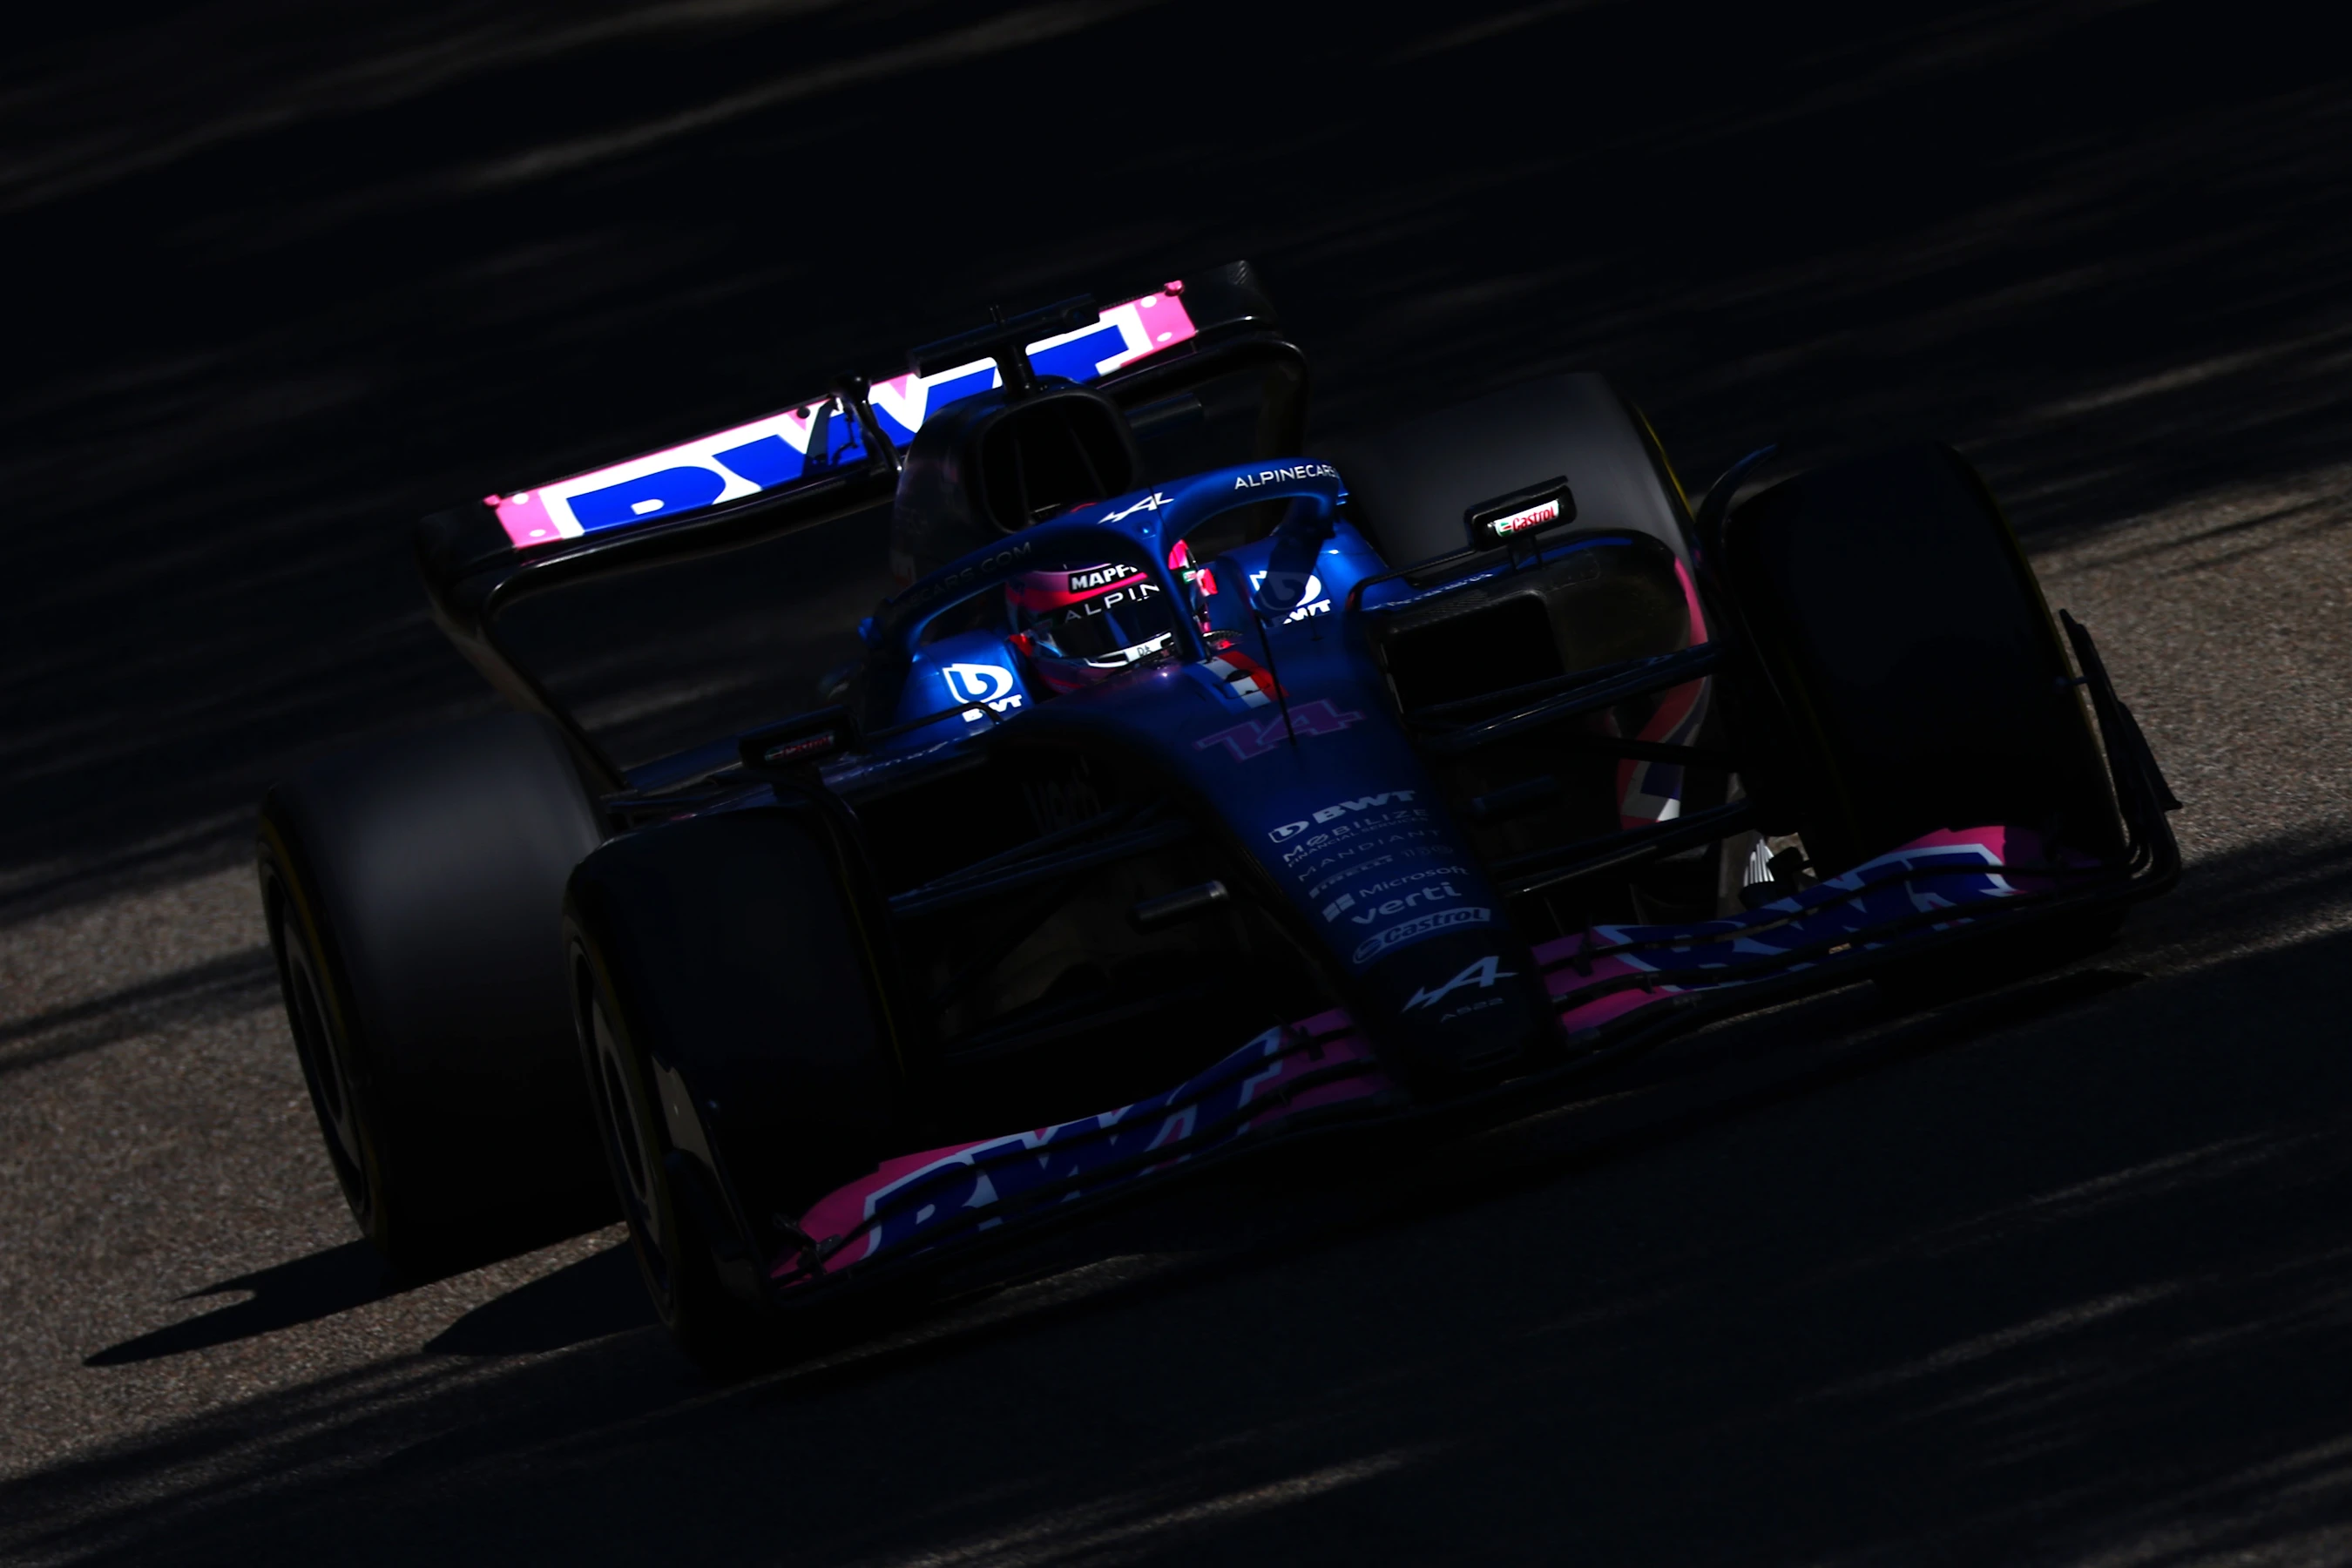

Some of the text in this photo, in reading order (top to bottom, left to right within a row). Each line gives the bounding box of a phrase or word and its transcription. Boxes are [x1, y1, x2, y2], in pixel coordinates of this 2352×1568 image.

[1511, 506, 1556, 533] Castrol
[1193, 698, 1367, 763] 14
[1312, 789, 1417, 824] BWT
[1359, 865, 1470, 898] Microsoft
[1351, 882, 1463, 924] verti
[1382, 909, 1484, 943] Castrol
